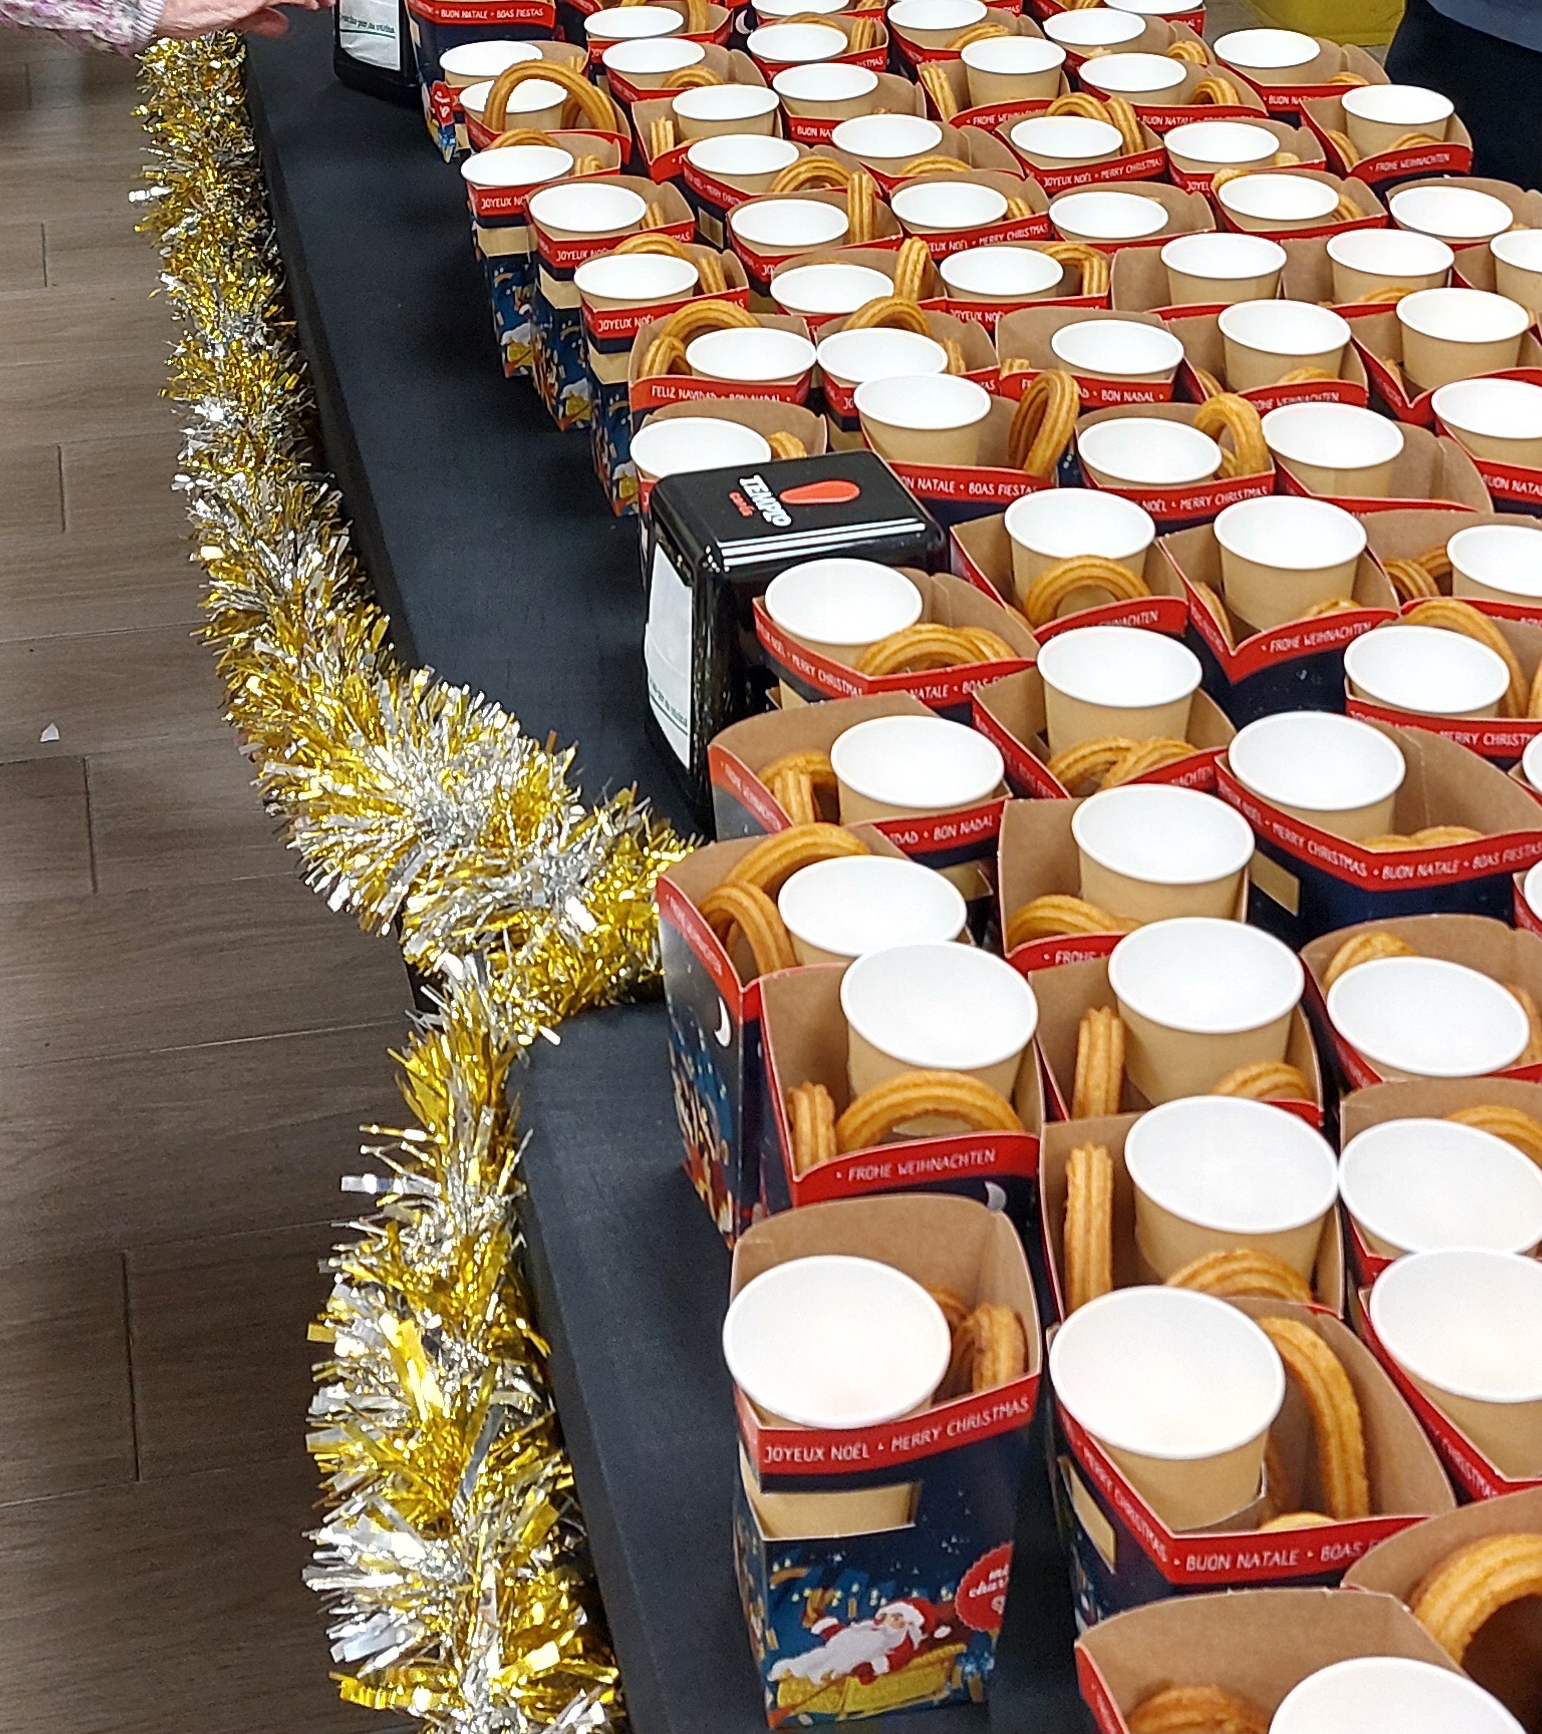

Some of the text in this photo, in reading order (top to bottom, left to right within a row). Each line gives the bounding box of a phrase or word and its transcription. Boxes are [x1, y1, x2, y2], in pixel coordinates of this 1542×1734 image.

[441, 7, 544, 20] BUON NATALE BOAS FIESTAS
[481, 197, 512, 210] JOYEUX
[1006, 223, 1048, 242] CHRISTMAS
[556, 249, 588, 262] JOYEUX
[597, 319, 633, 333] JOYEUX
[651, 385, 676, 399] FELIZ
[1101, 388, 1156, 402] BON NADAL
[916, 479, 955, 495] NATALE
[968, 481, 996, 496] BOAS
[1179, 495, 1213, 511] MERRY
[1270, 634, 1301, 652] FROHE
[1482, 732, 1535, 747] CHRISTM
[932, 825, 956, 841] BON
[1381, 864, 1414, 881] BUON
[1416, 858, 1460, 879] NATALE
[848, 1148, 997, 1182] FROHE WEIHNACHTEN
[763, 1396, 1031, 1464] JOYEUX NOËL MERRY CHRISTMAS
[1185, 1554, 1231, 1572] BUON
[1235, 1548, 1299, 1570] NATALE
[1320, 1542, 1361, 1563] BOAS
